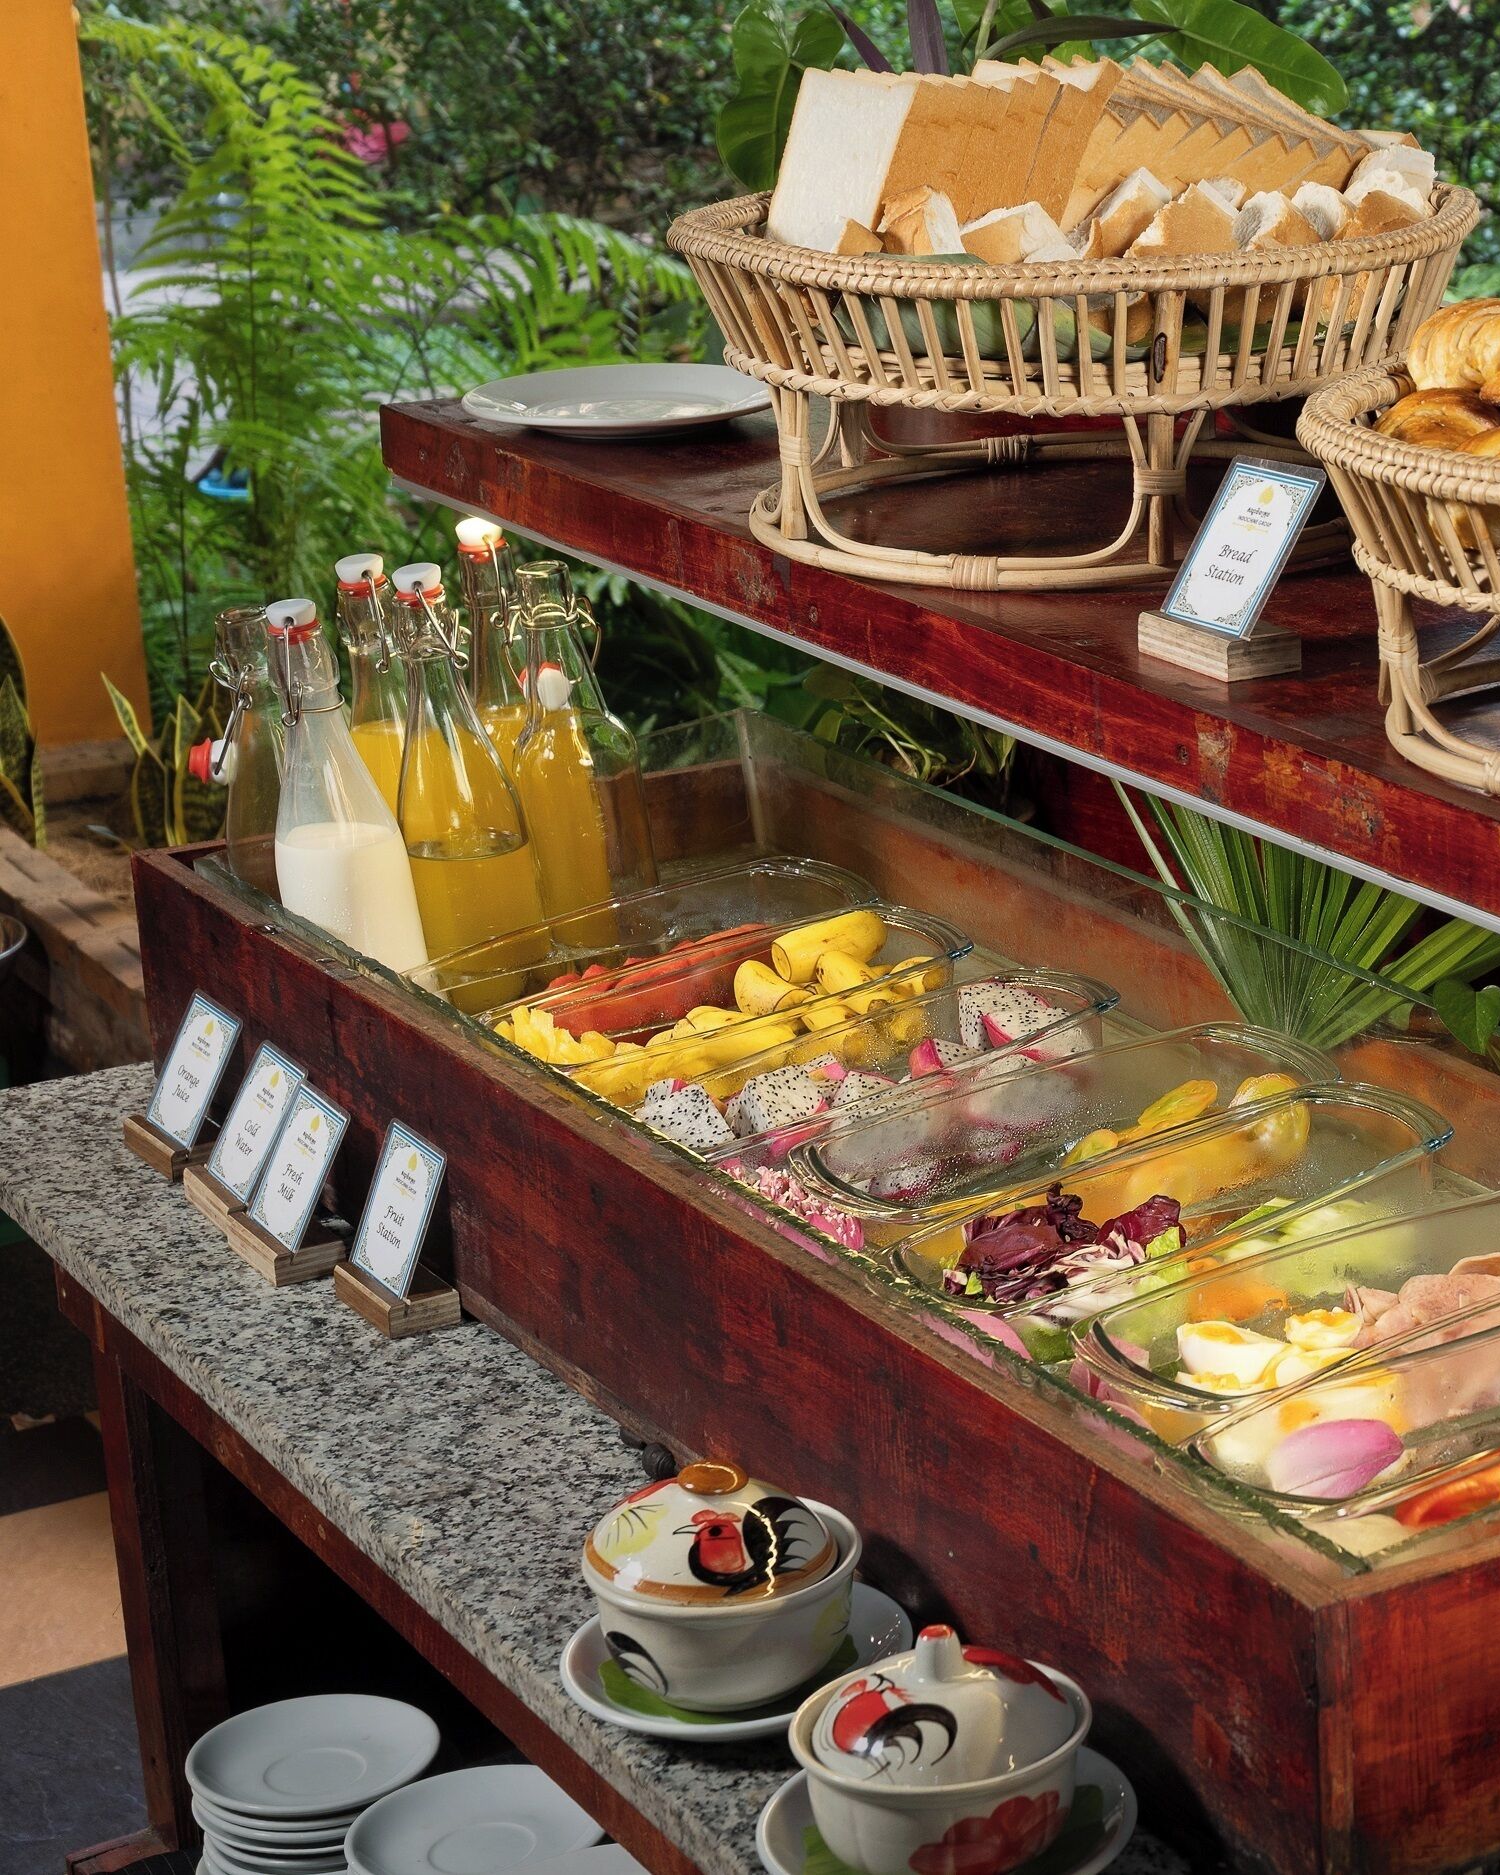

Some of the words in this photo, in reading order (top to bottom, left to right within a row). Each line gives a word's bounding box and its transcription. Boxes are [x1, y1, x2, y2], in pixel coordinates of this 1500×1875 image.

[1218, 544, 1258, 564] Bread
[1205, 564, 1245, 586] Station
[177, 1064, 201, 1090] Orange
[171, 1085, 190, 1103] Juice
[244, 1119, 260, 1136] Cold
[235, 1134, 254, 1157] Water
[282, 1163, 303, 1186] Fresh
[277, 1184, 296, 1203] Milk
[385, 1206, 406, 1227] Fruit
[376, 1222, 401, 1249] Station
